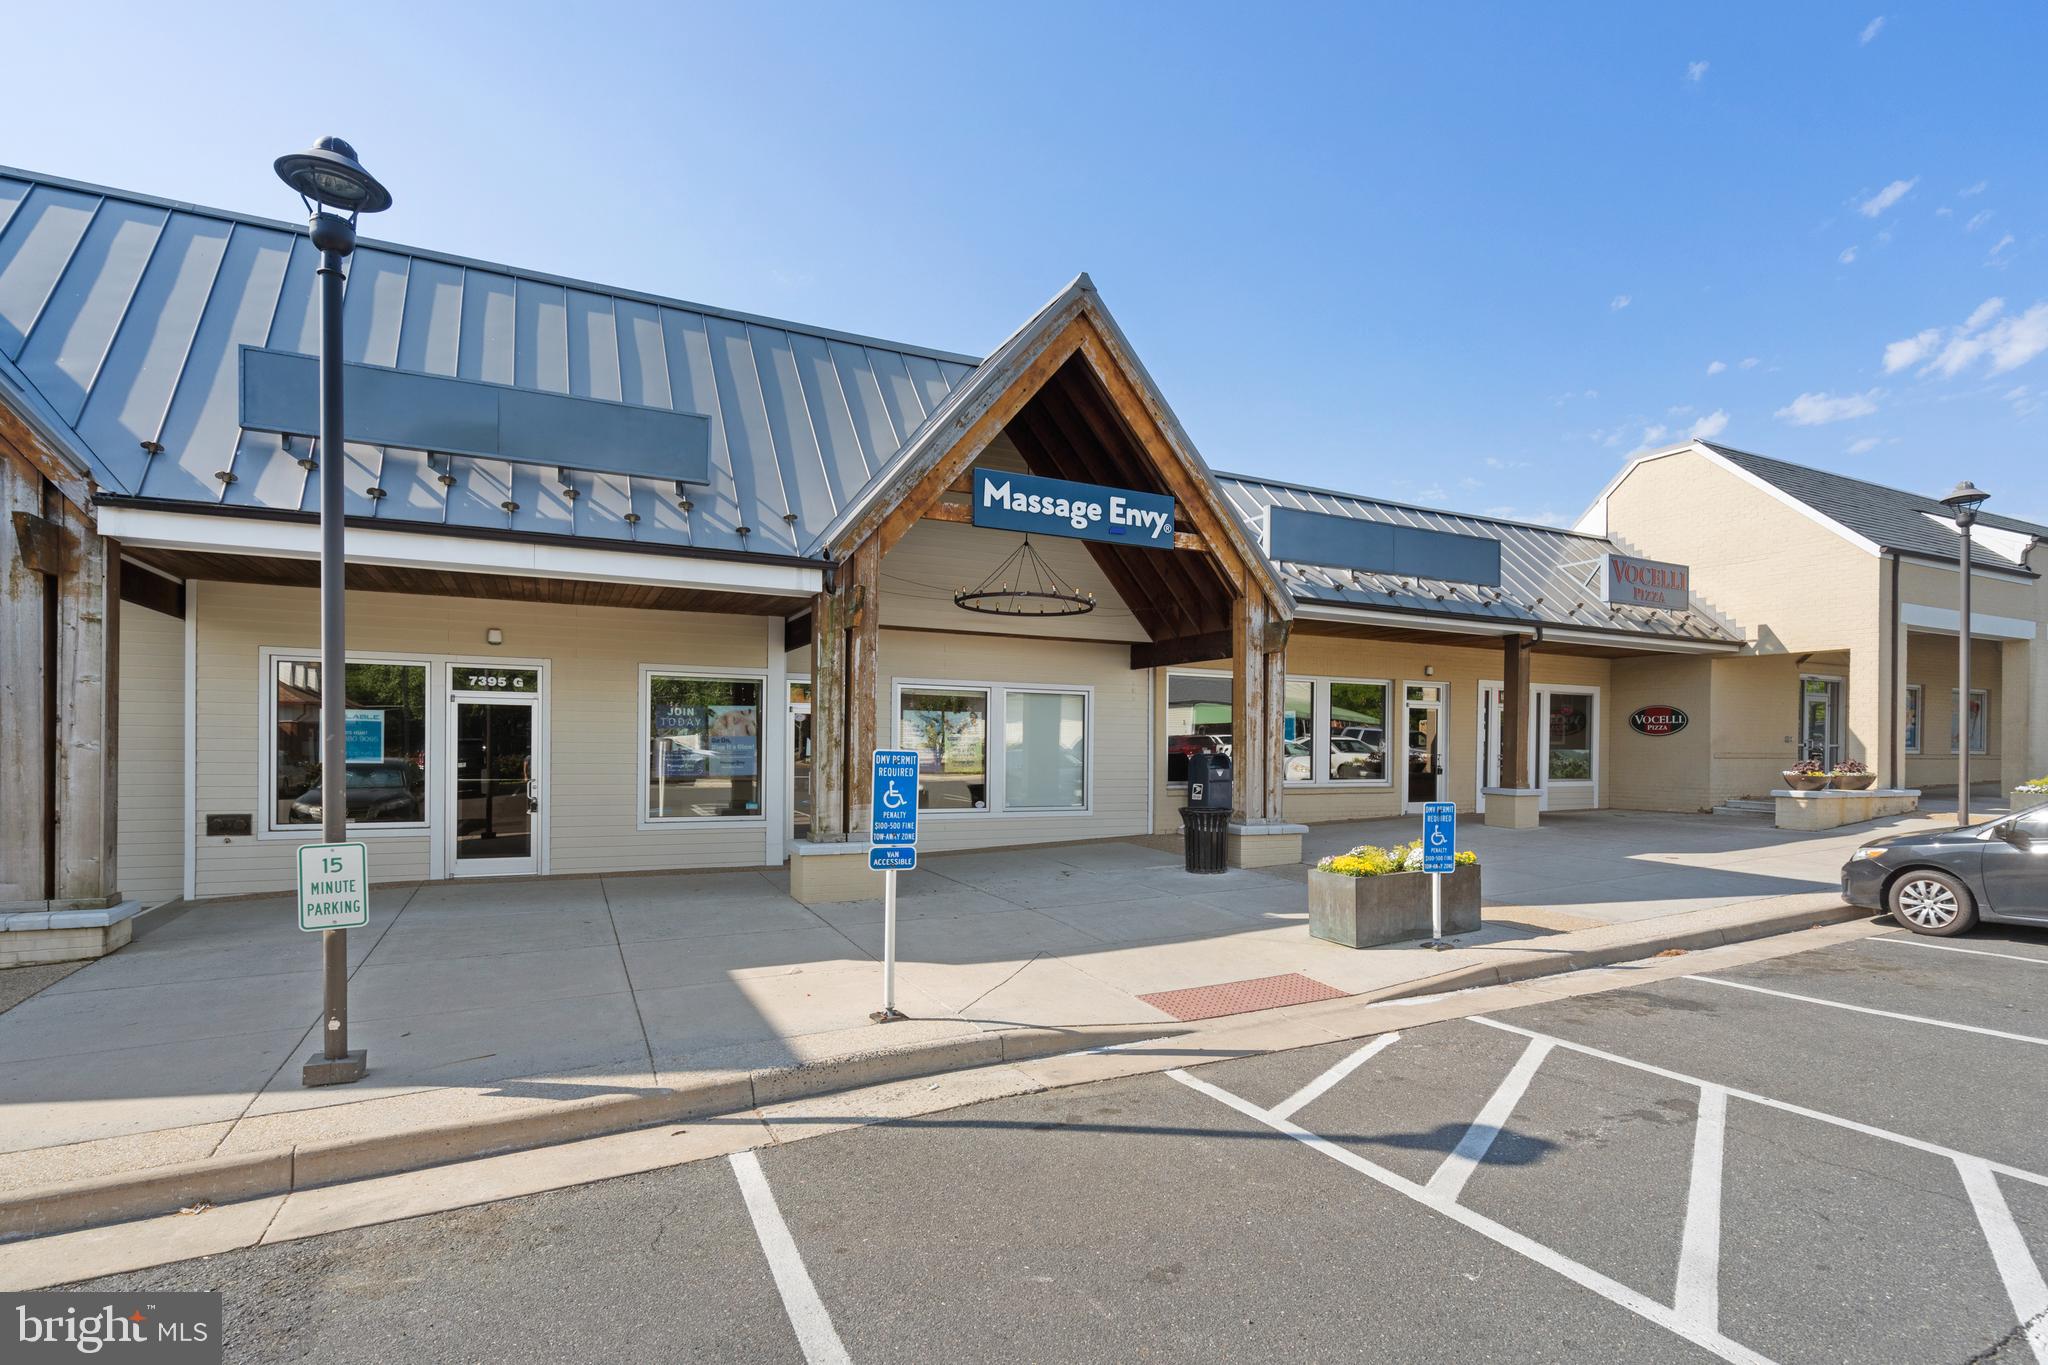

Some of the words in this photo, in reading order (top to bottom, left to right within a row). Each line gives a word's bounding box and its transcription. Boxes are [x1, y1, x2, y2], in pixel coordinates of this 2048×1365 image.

[984, 477, 1102, 529] Massage
[1612, 559, 1687, 592] VOCELLI
[1634, 587, 1665, 603] PIZZA
[468, 676, 507, 687] 7395
[513, 677, 524, 688] G
[667, 707, 695, 716] JOIN
[660, 718, 702, 727] TODAY
[1635, 714, 1685, 725] VOCELLI
[875, 754, 890, 765] DMV
[892, 755, 917, 765] PERMIT
[878, 767, 914, 777] REQUIRED
[882, 811, 907, 819] PENALTY
[902, 822, 915, 830] FINE
[901, 832, 916, 841] ZONE
[321, 857, 343, 874] 15
[874, 858, 912, 866] ACCESSIBLE
[311, 879, 357, 896] MINUTE
[307, 899, 361, 917] PARKING
